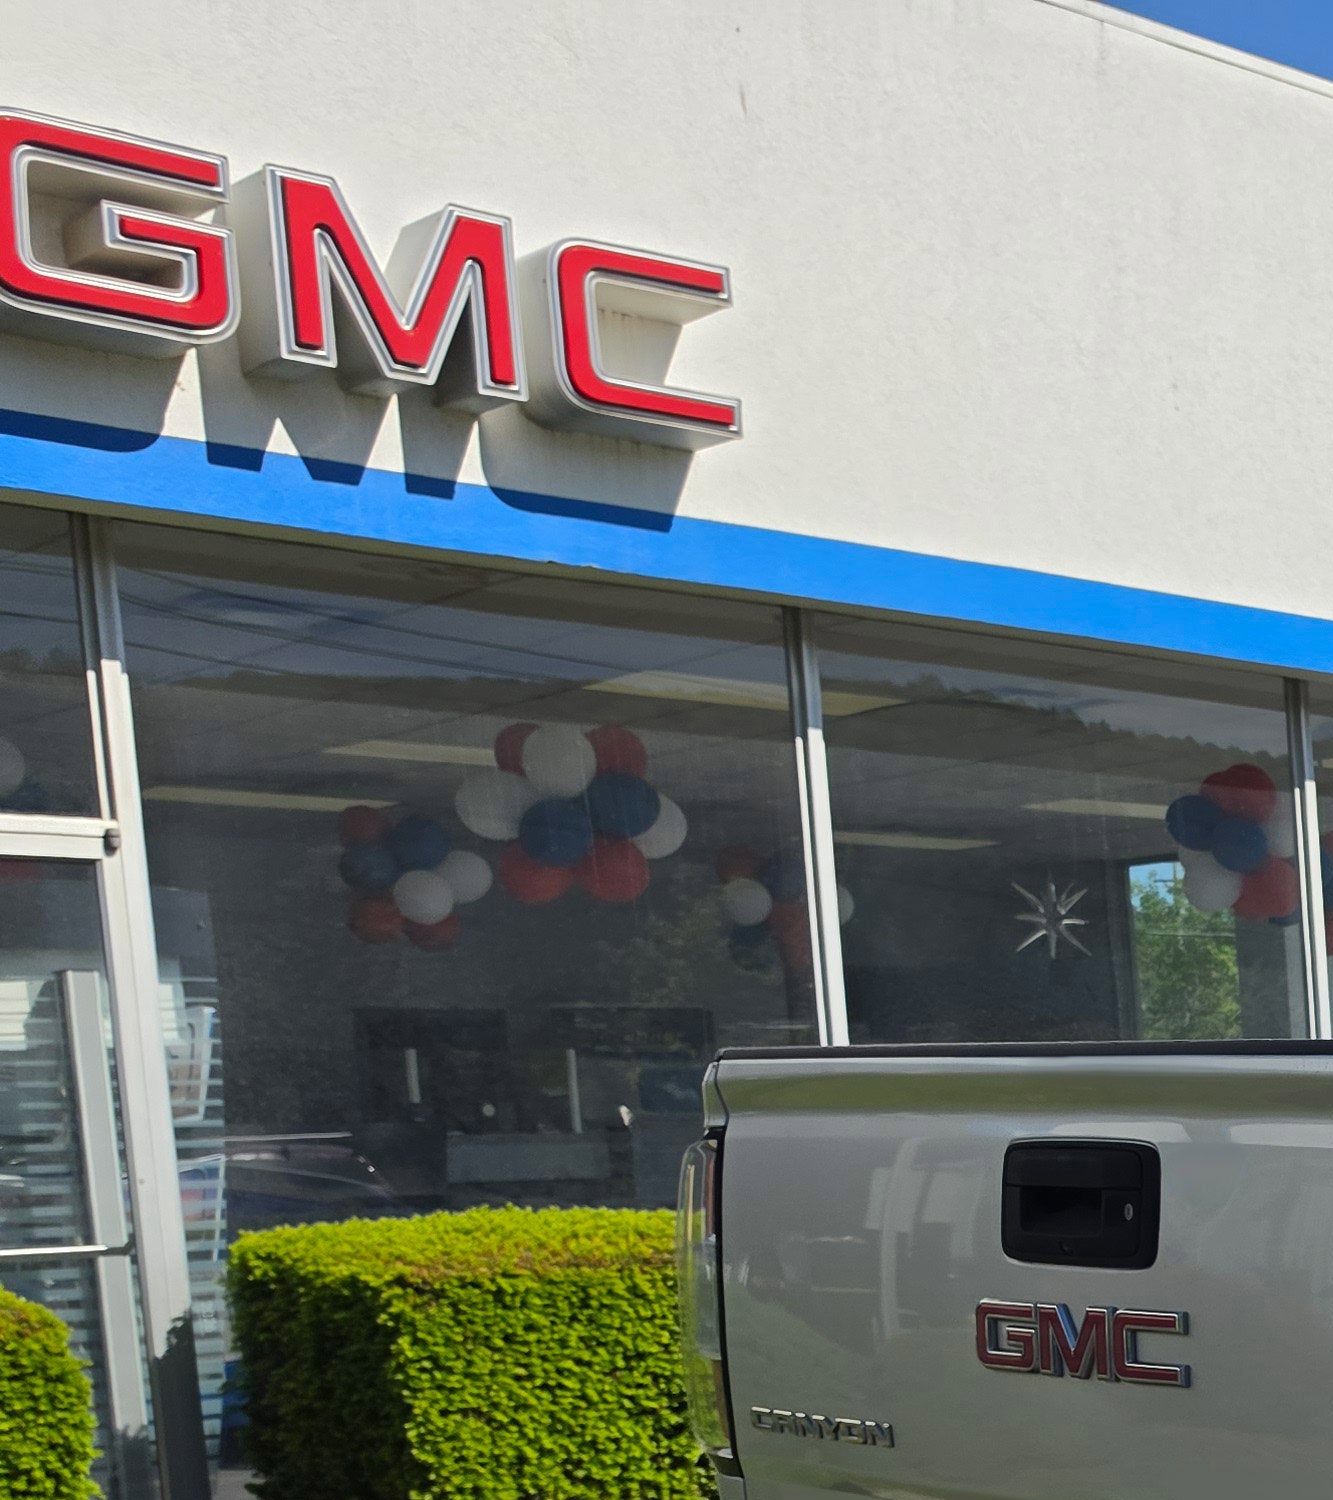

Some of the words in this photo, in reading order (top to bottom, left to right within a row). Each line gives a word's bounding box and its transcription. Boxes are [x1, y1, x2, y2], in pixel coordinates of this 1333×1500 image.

[0, 106, 742, 440] GMC
[976, 1298, 1191, 1388] GMC
[751, 1406, 895, 1448] CANYON
